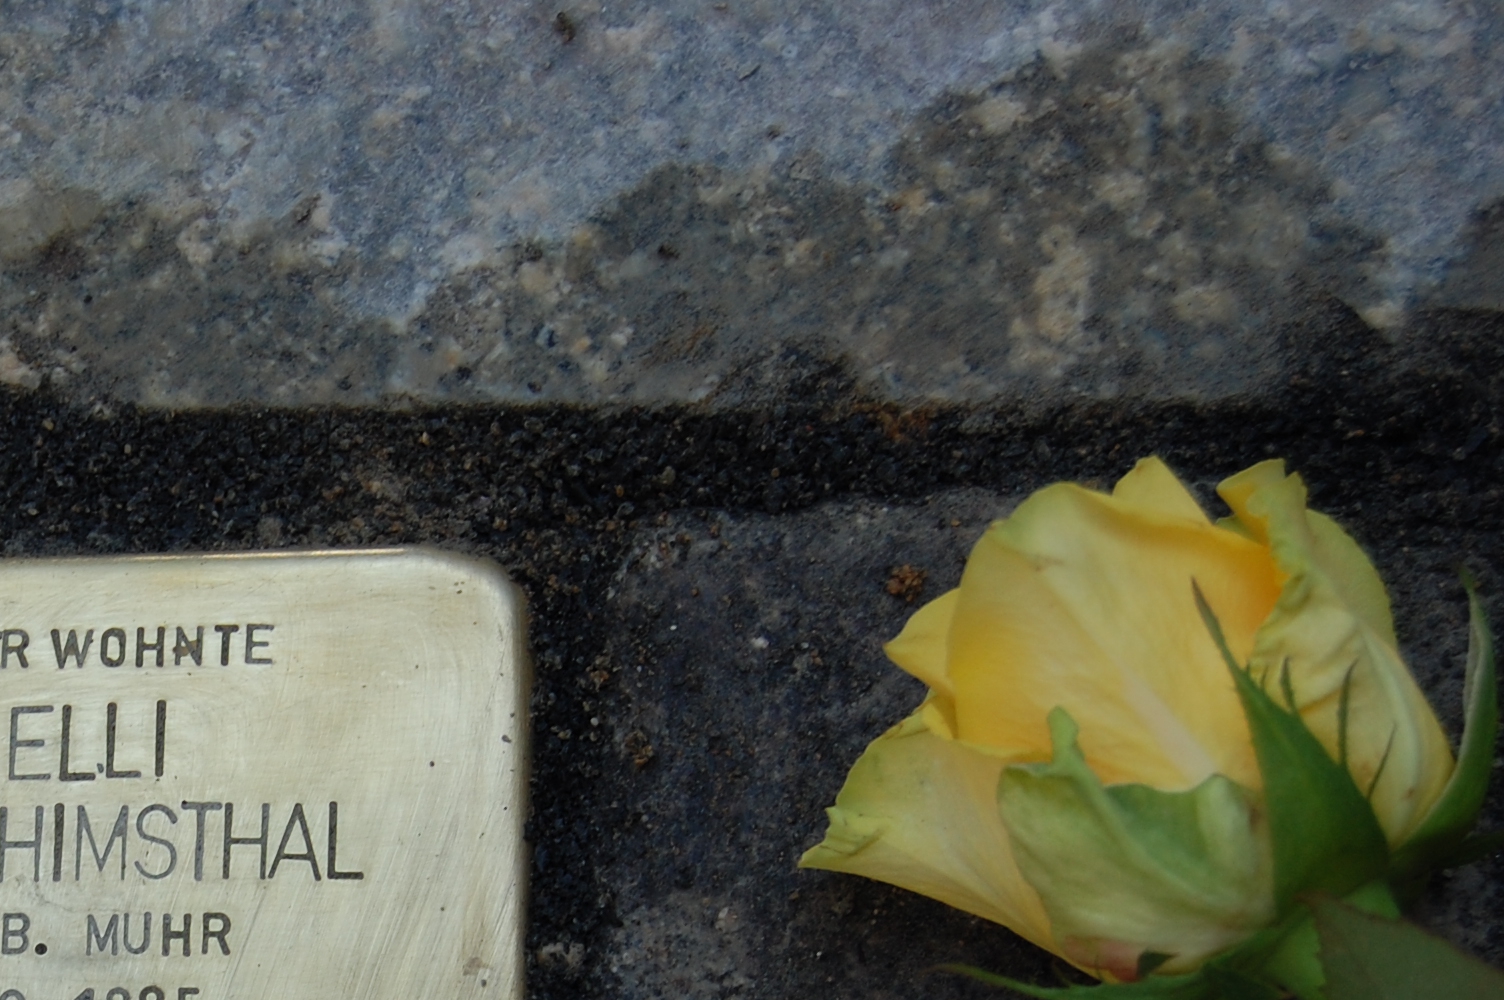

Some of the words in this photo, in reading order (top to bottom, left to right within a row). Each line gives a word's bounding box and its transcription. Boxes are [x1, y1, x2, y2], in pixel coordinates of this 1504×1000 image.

[50, 623, 275, 669] WOHNTE
[8, 699, 167, 782] ELLI
[85, 912, 232, 957] MUHR
